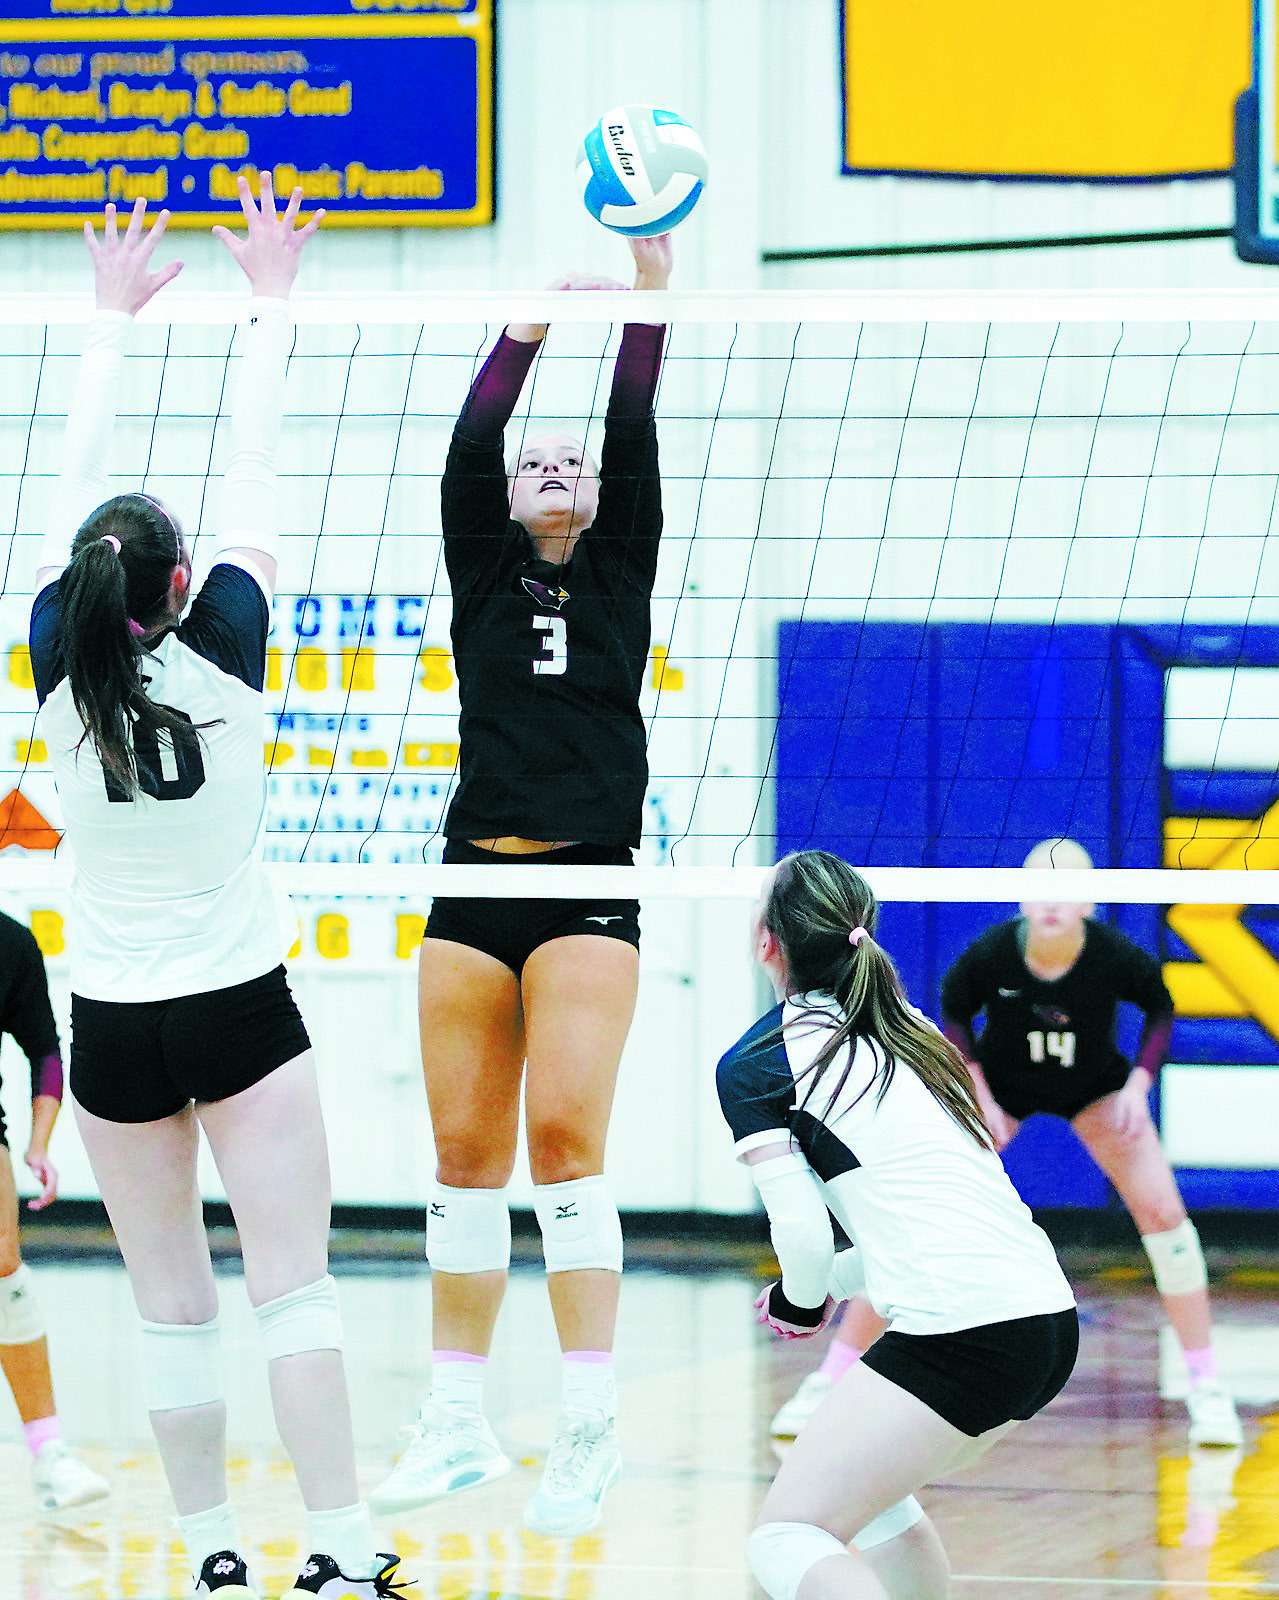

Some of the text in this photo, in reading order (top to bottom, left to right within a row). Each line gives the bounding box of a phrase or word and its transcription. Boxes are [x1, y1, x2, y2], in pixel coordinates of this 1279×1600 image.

[608, 125, 635, 176] Baden
[273, 598, 423, 638] OME
[532, 614, 568, 675] 3
[1026, 1030, 1077, 1068] 14
